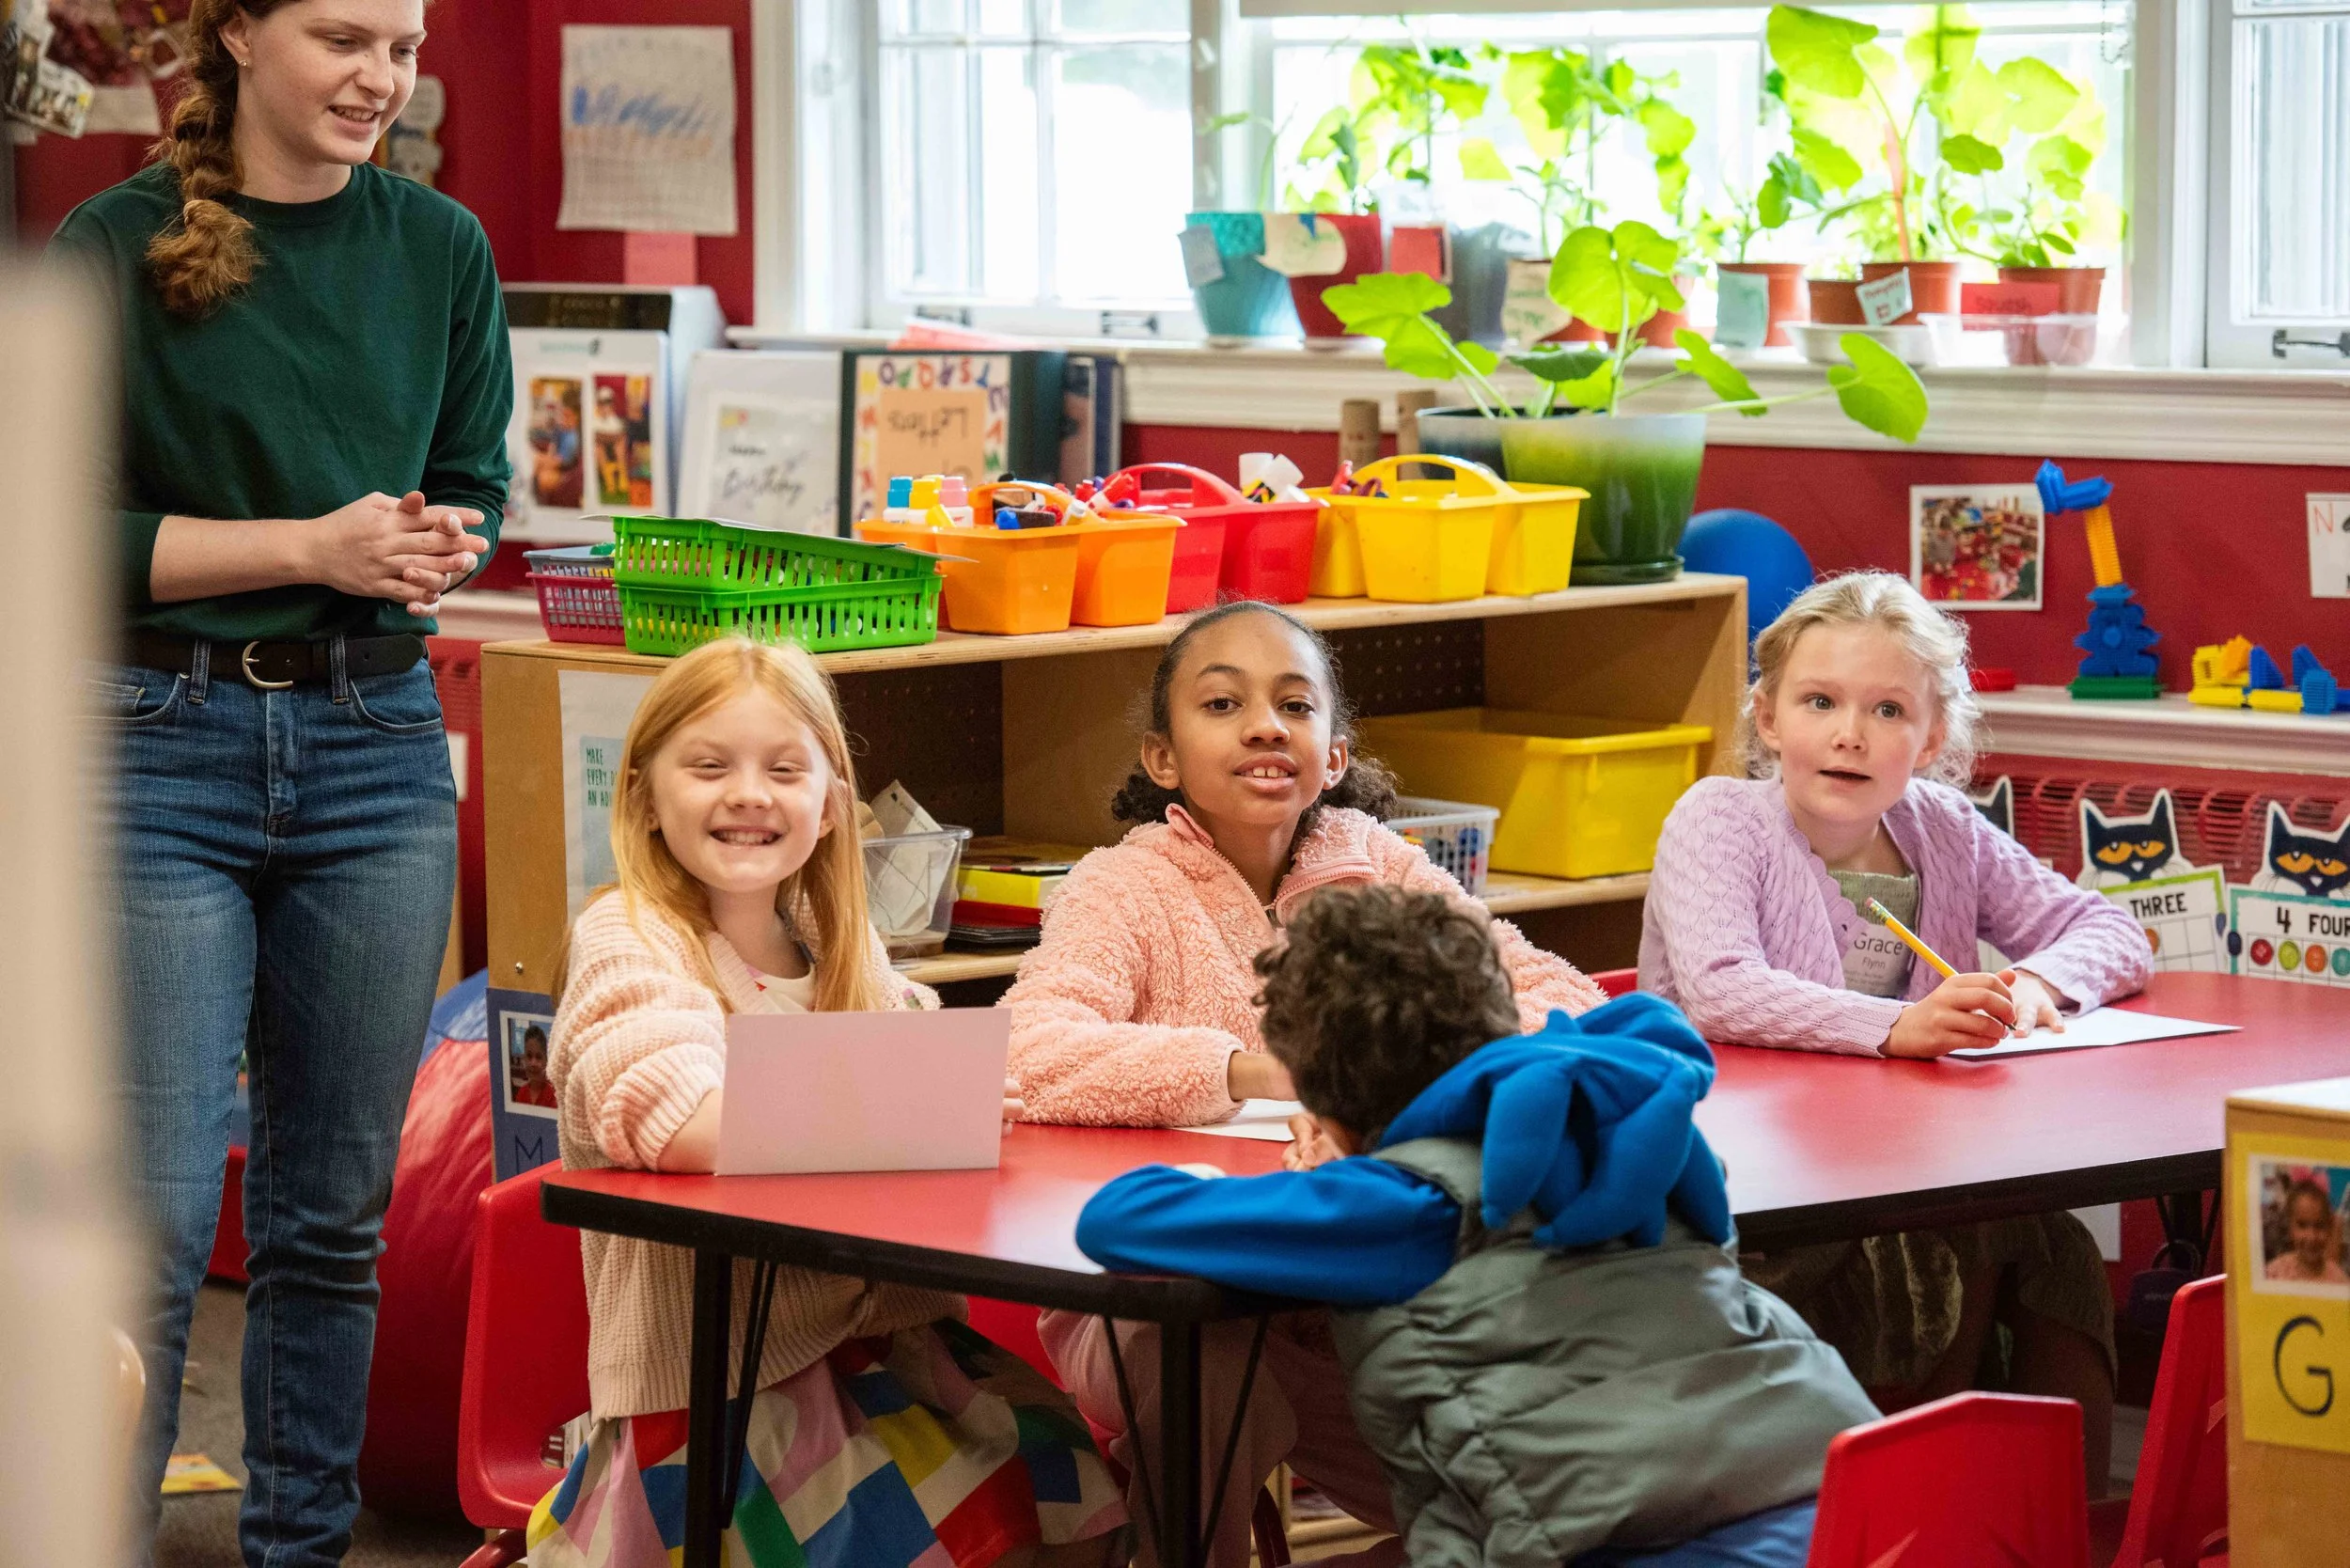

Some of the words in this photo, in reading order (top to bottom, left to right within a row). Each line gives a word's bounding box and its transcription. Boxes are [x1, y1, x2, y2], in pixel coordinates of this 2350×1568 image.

[587, 768, 607, 786] EVERY
[588, 790, 597, 807] AN
[2129, 893, 2188, 919] THREE
[2277, 906, 2292, 933] 4
[1854, 932, 1903, 955] Grace
[1862, 957, 1886, 970] Flynn
[514, 1135, 544, 1175] M
[2272, 1313, 2335, 1419] G
